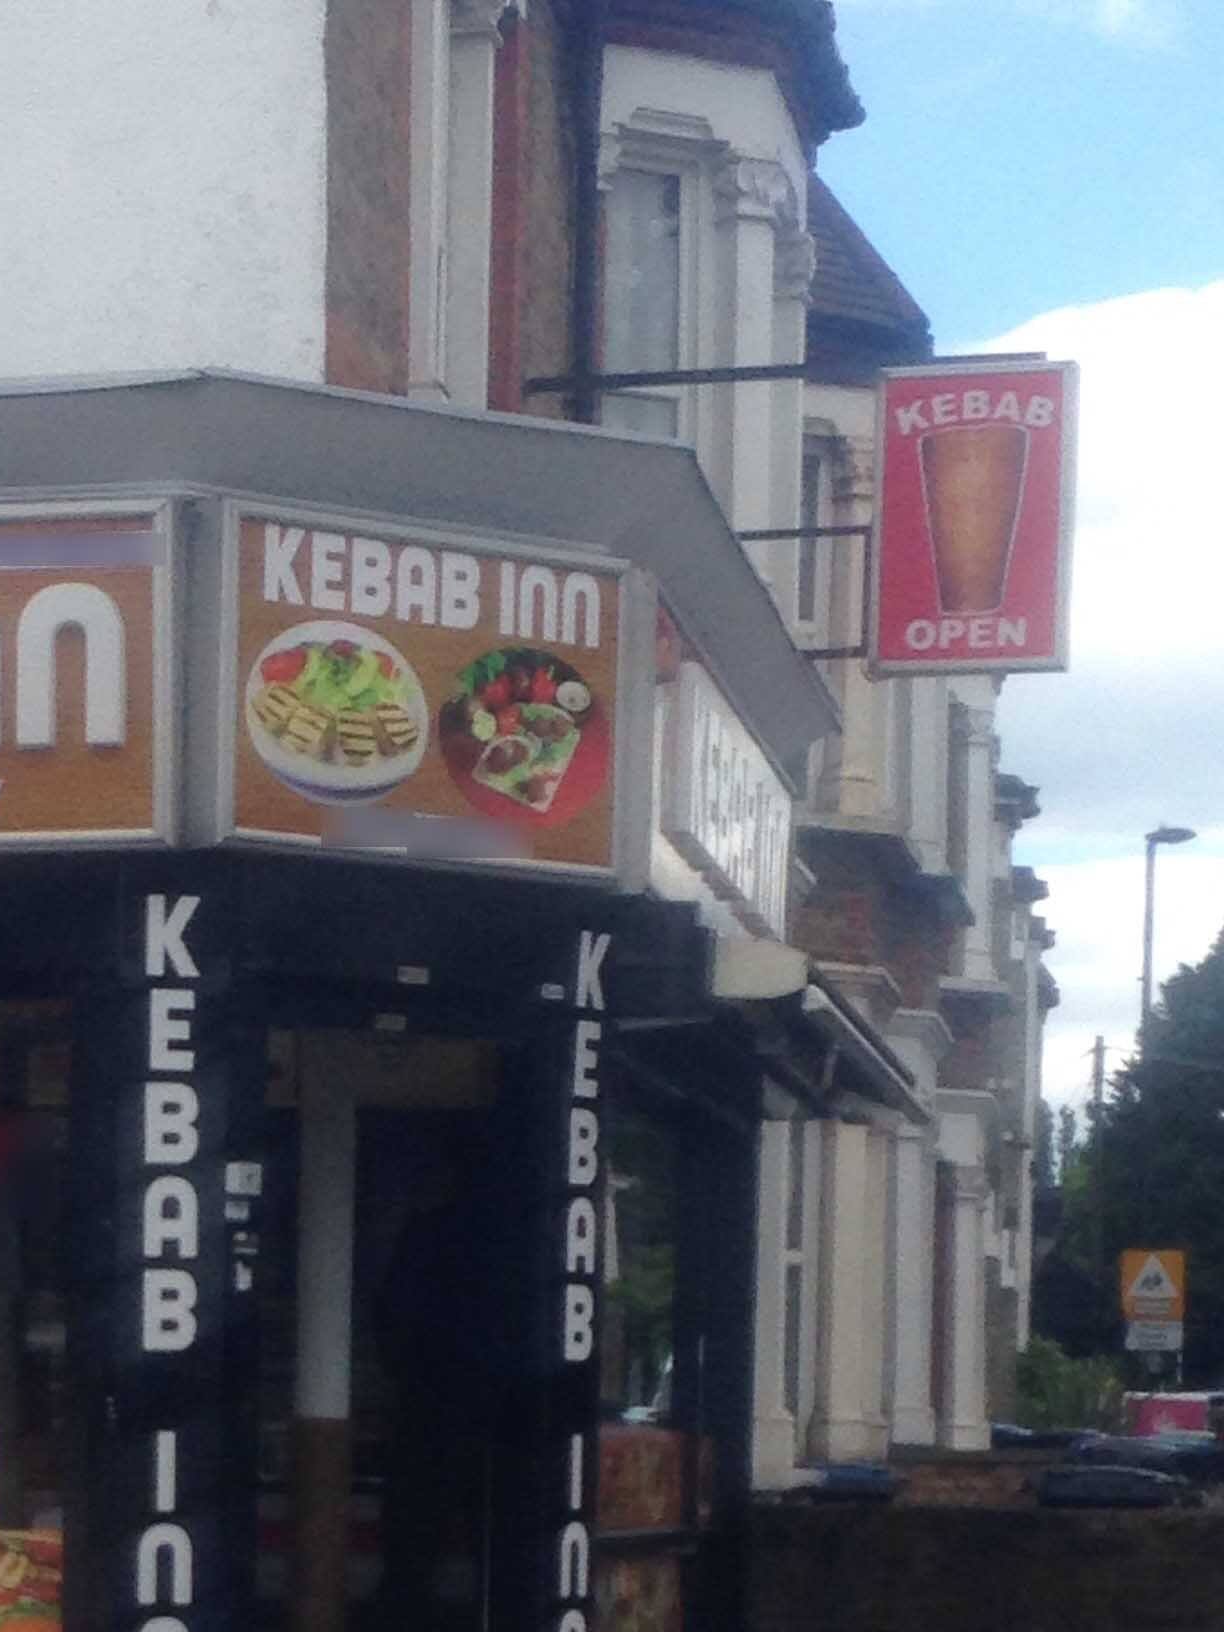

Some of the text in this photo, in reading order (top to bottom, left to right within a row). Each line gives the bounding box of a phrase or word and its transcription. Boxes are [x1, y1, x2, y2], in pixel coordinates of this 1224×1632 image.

[895, 390, 1055, 436] KEBAB
[264, 521, 480, 629] KEBAB
[904, 617, 1027, 651] OPEN
[141, 894, 201, 1352] KEBAB
[563, 929, 612, 1362] KEBAB
